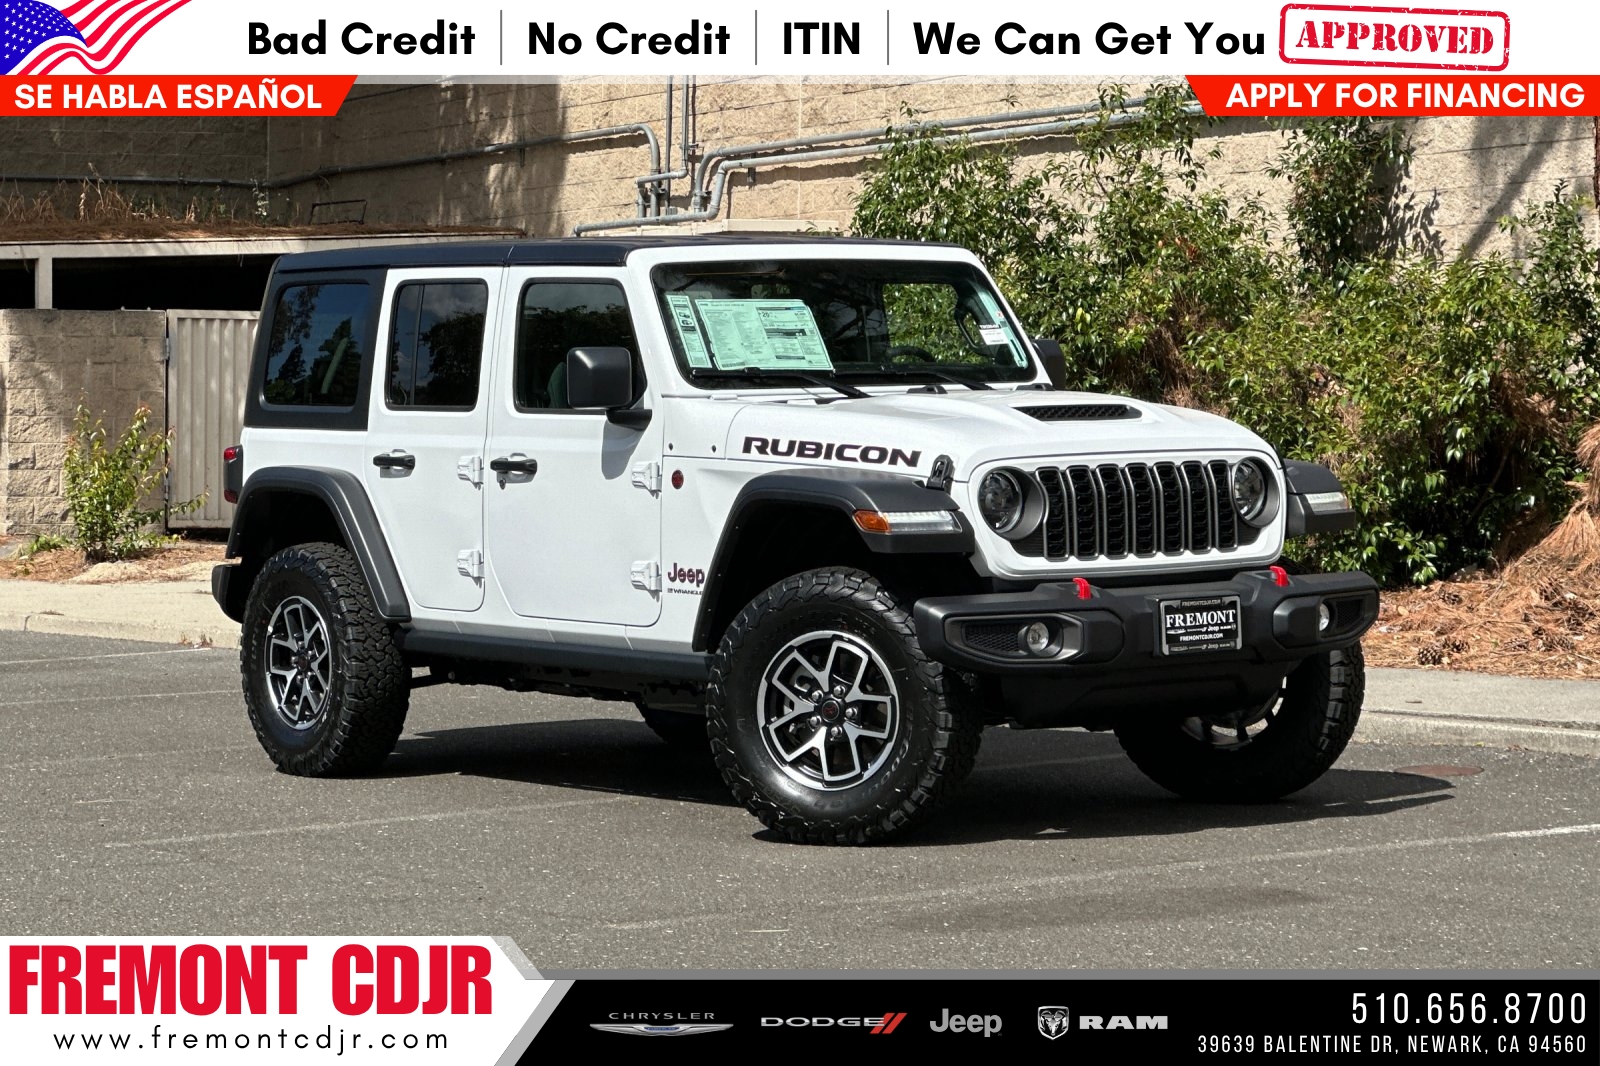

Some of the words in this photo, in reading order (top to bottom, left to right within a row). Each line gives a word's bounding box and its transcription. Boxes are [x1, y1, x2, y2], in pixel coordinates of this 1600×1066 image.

[742, 436, 922, 468] RUBICON
[668, 562, 705, 588] Jeep
[674, 588, 703, 596] WRANGLE
[1166, 610, 1236, 627] FREMONT
[1179, 633, 1224, 641] FREMONTCDJR.COM
